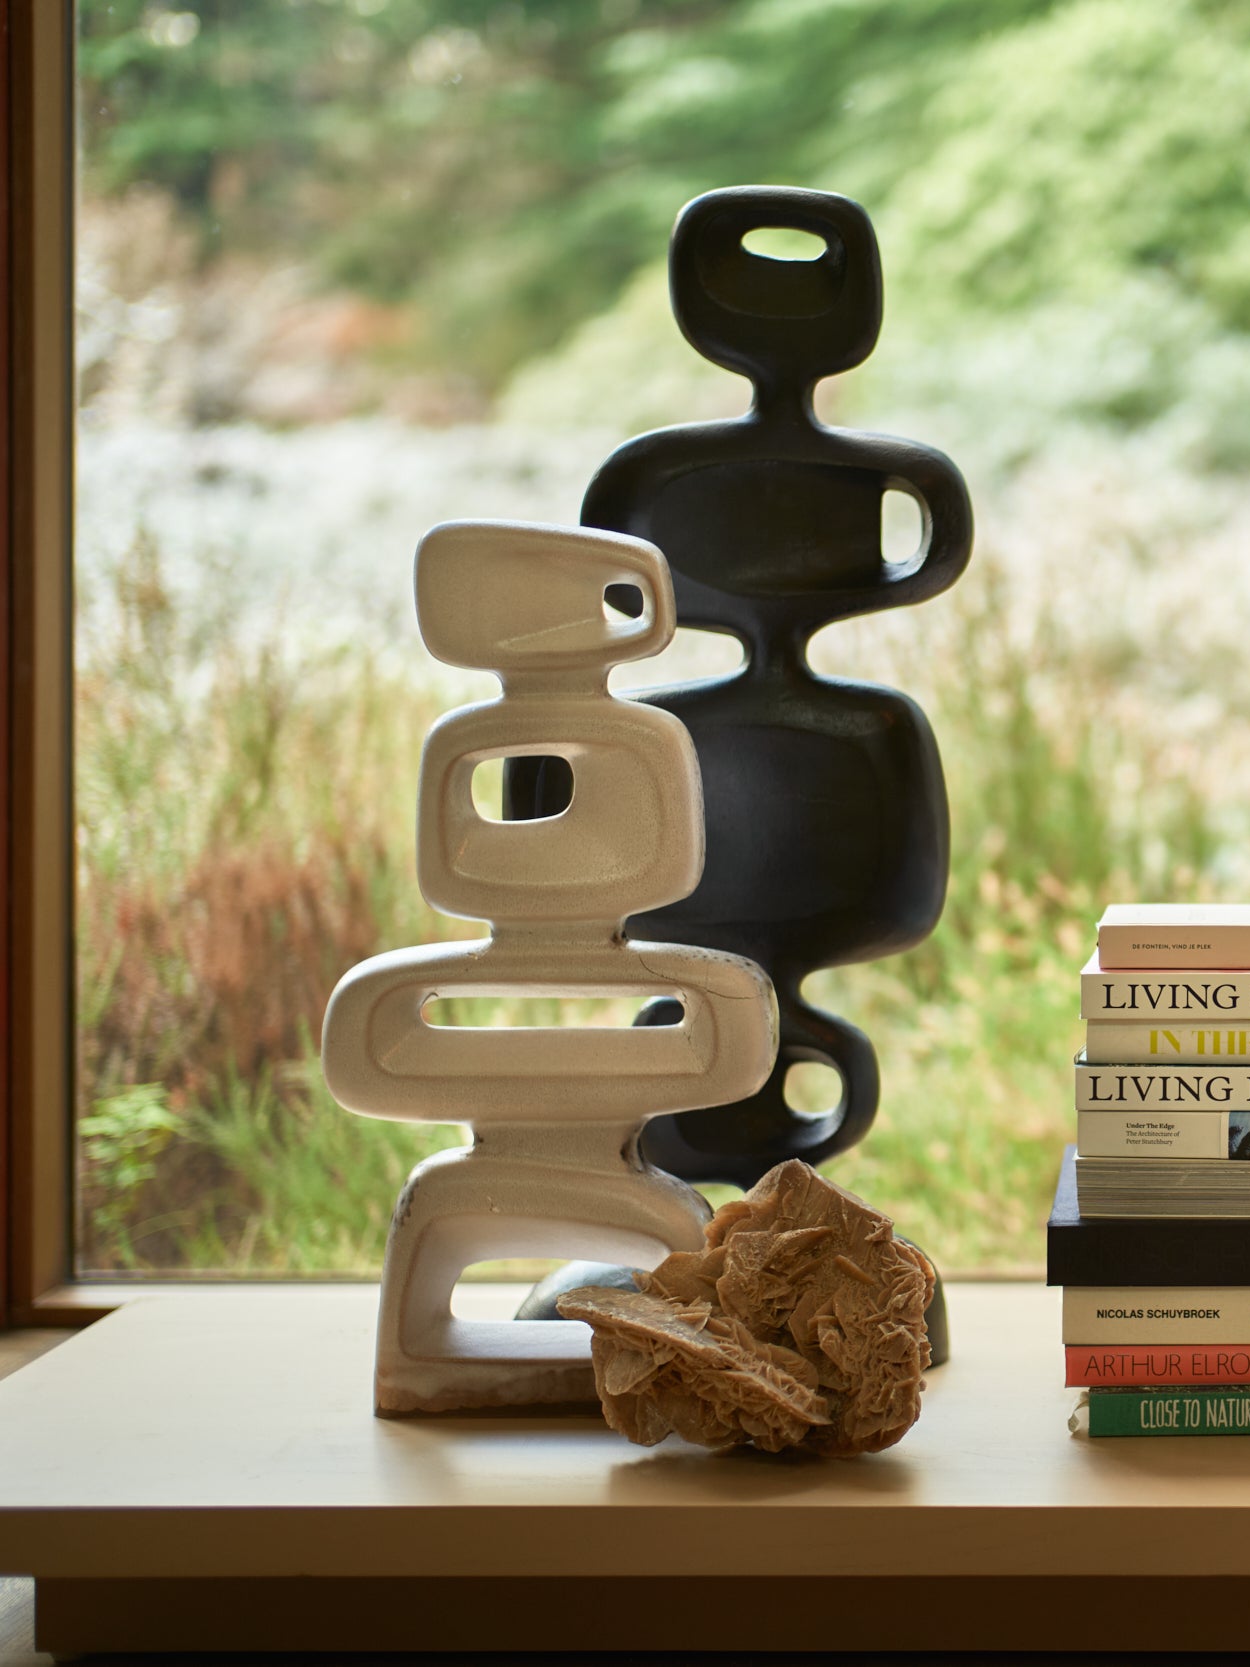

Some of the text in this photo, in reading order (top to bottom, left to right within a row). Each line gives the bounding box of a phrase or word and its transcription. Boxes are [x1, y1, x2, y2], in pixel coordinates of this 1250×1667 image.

[1102, 984, 1240, 1009] LIVING
[1150, 1030, 1183, 1055] IN
[1088, 1075, 1233, 1101] LIVING
[1159, 1122, 1175, 1131] Edge
[1142, 1138, 1173, 1146] Stutchbury
[1096, 1309, 1221, 1319] NICOLAS SCHUYBROEK
[1084, 1354, 1182, 1377] ARTHUR
[1140, 1399, 1180, 1428] CLOSE
[1183, 1398, 1200, 1427] TO
